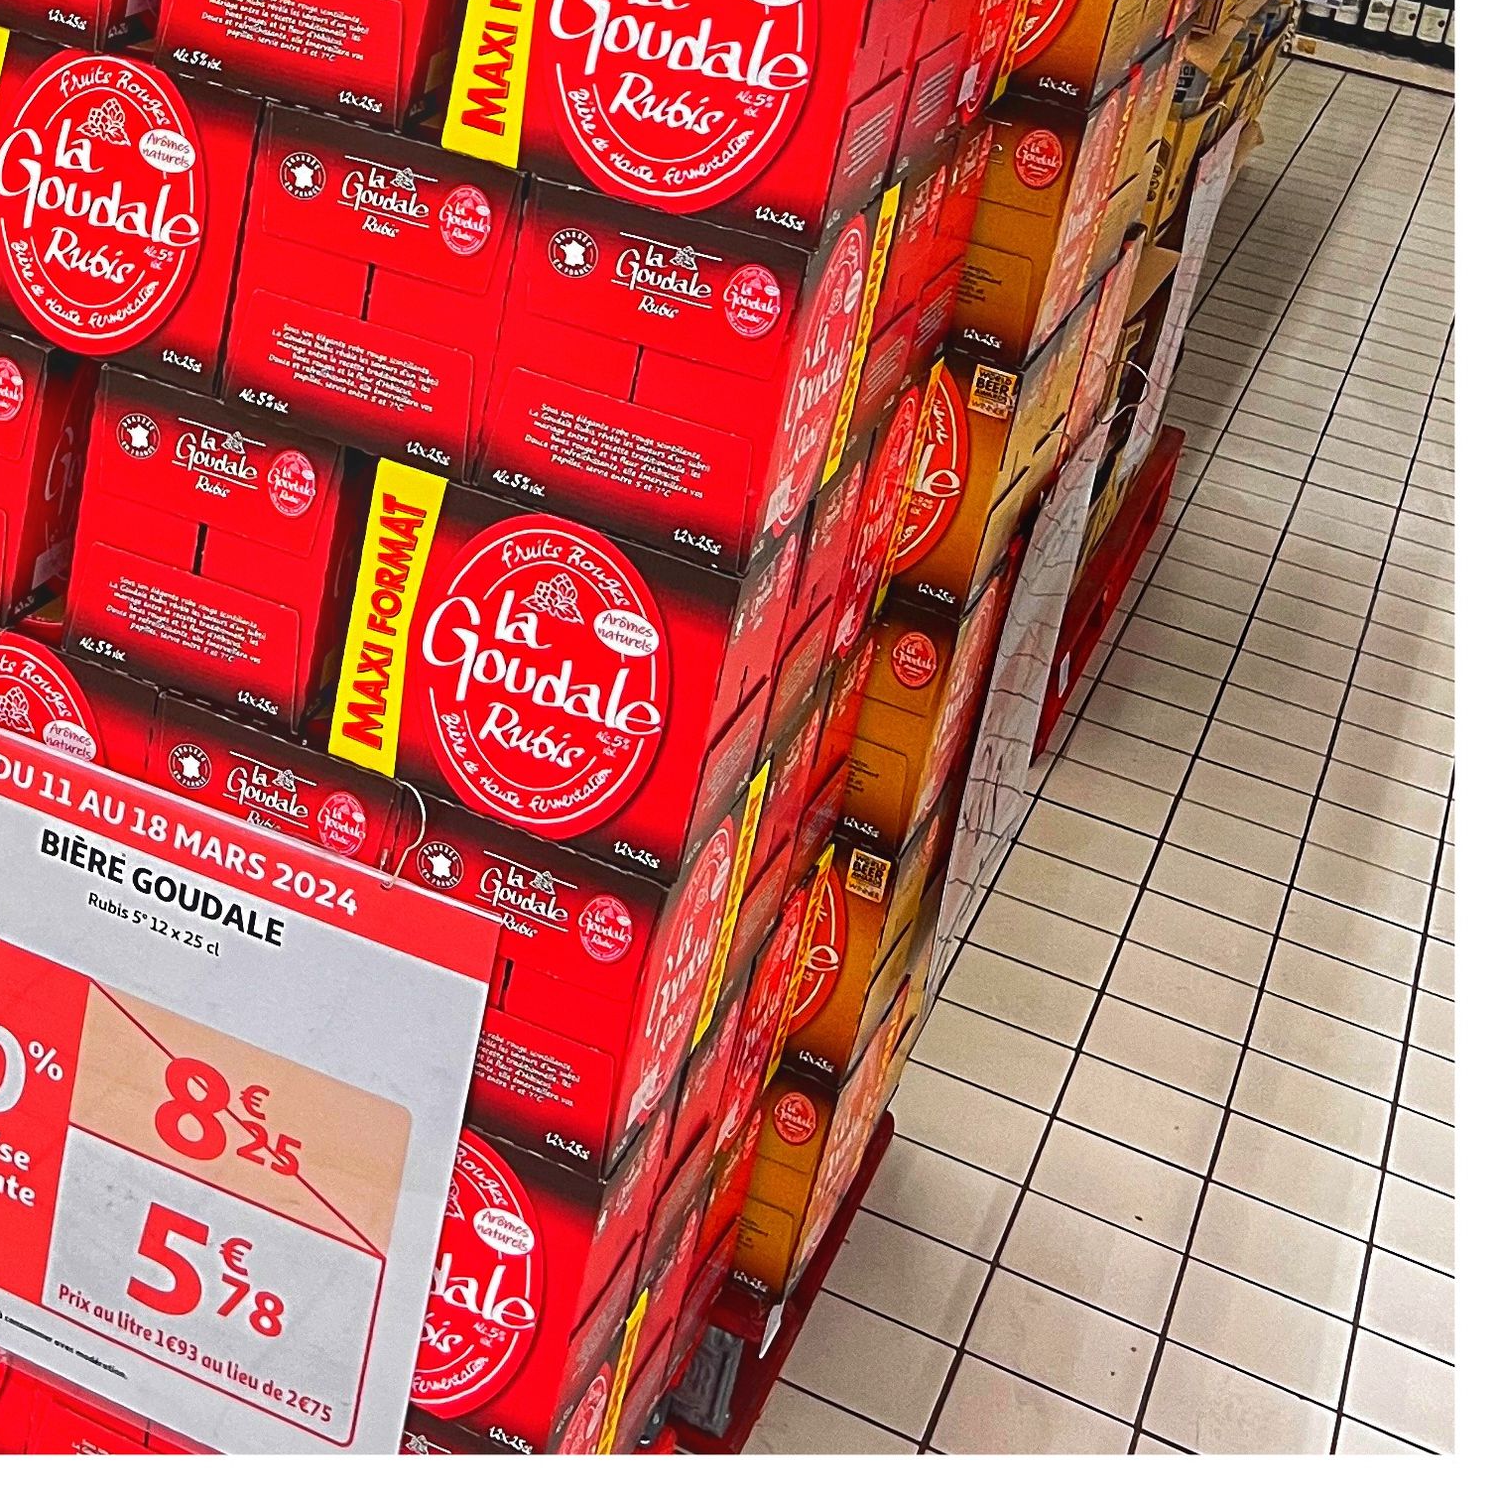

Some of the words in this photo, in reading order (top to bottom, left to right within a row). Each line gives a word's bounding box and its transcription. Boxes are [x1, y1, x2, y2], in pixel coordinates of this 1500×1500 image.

[461, 12, 518, 137] MAXI
[609, 72, 726, 135] Rubis
[368, 493, 428, 637] FORMAT
[494, 589, 552, 650] la
[341, 635, 399, 751] MAXI
[421, 597, 663, 736] Goudale
[478, 702, 588, 769] Rubis
[39, 828, 127, 884] BIÈRE
[132, 866, 287, 947] GOUDALE
[41, 769, 74, 808] 11
[79, 786, 127, 827] AU
[133, 802, 170, 842] 18
[174, 817, 270, 881] MARS
[273, 860, 359, 917] 2024
[88, 891, 130, 921] Rubis
[149, 914, 169, 935] 12
[183, 927, 205, 950] 25
[206, 937, 220, 958] cl
[58, 1283, 91, 1317] Prix
[92, 1303, 115, 1327] au
[117, 1306, 153, 1345] litre
[155, 1323, 199, 1362] 1€93
[201, 1350, 223, 1373] au
[225, 1352, 260, 1393] lieu
[261, 1371, 283, 1403] de
[286, 1386, 332, 1424] 2€75
